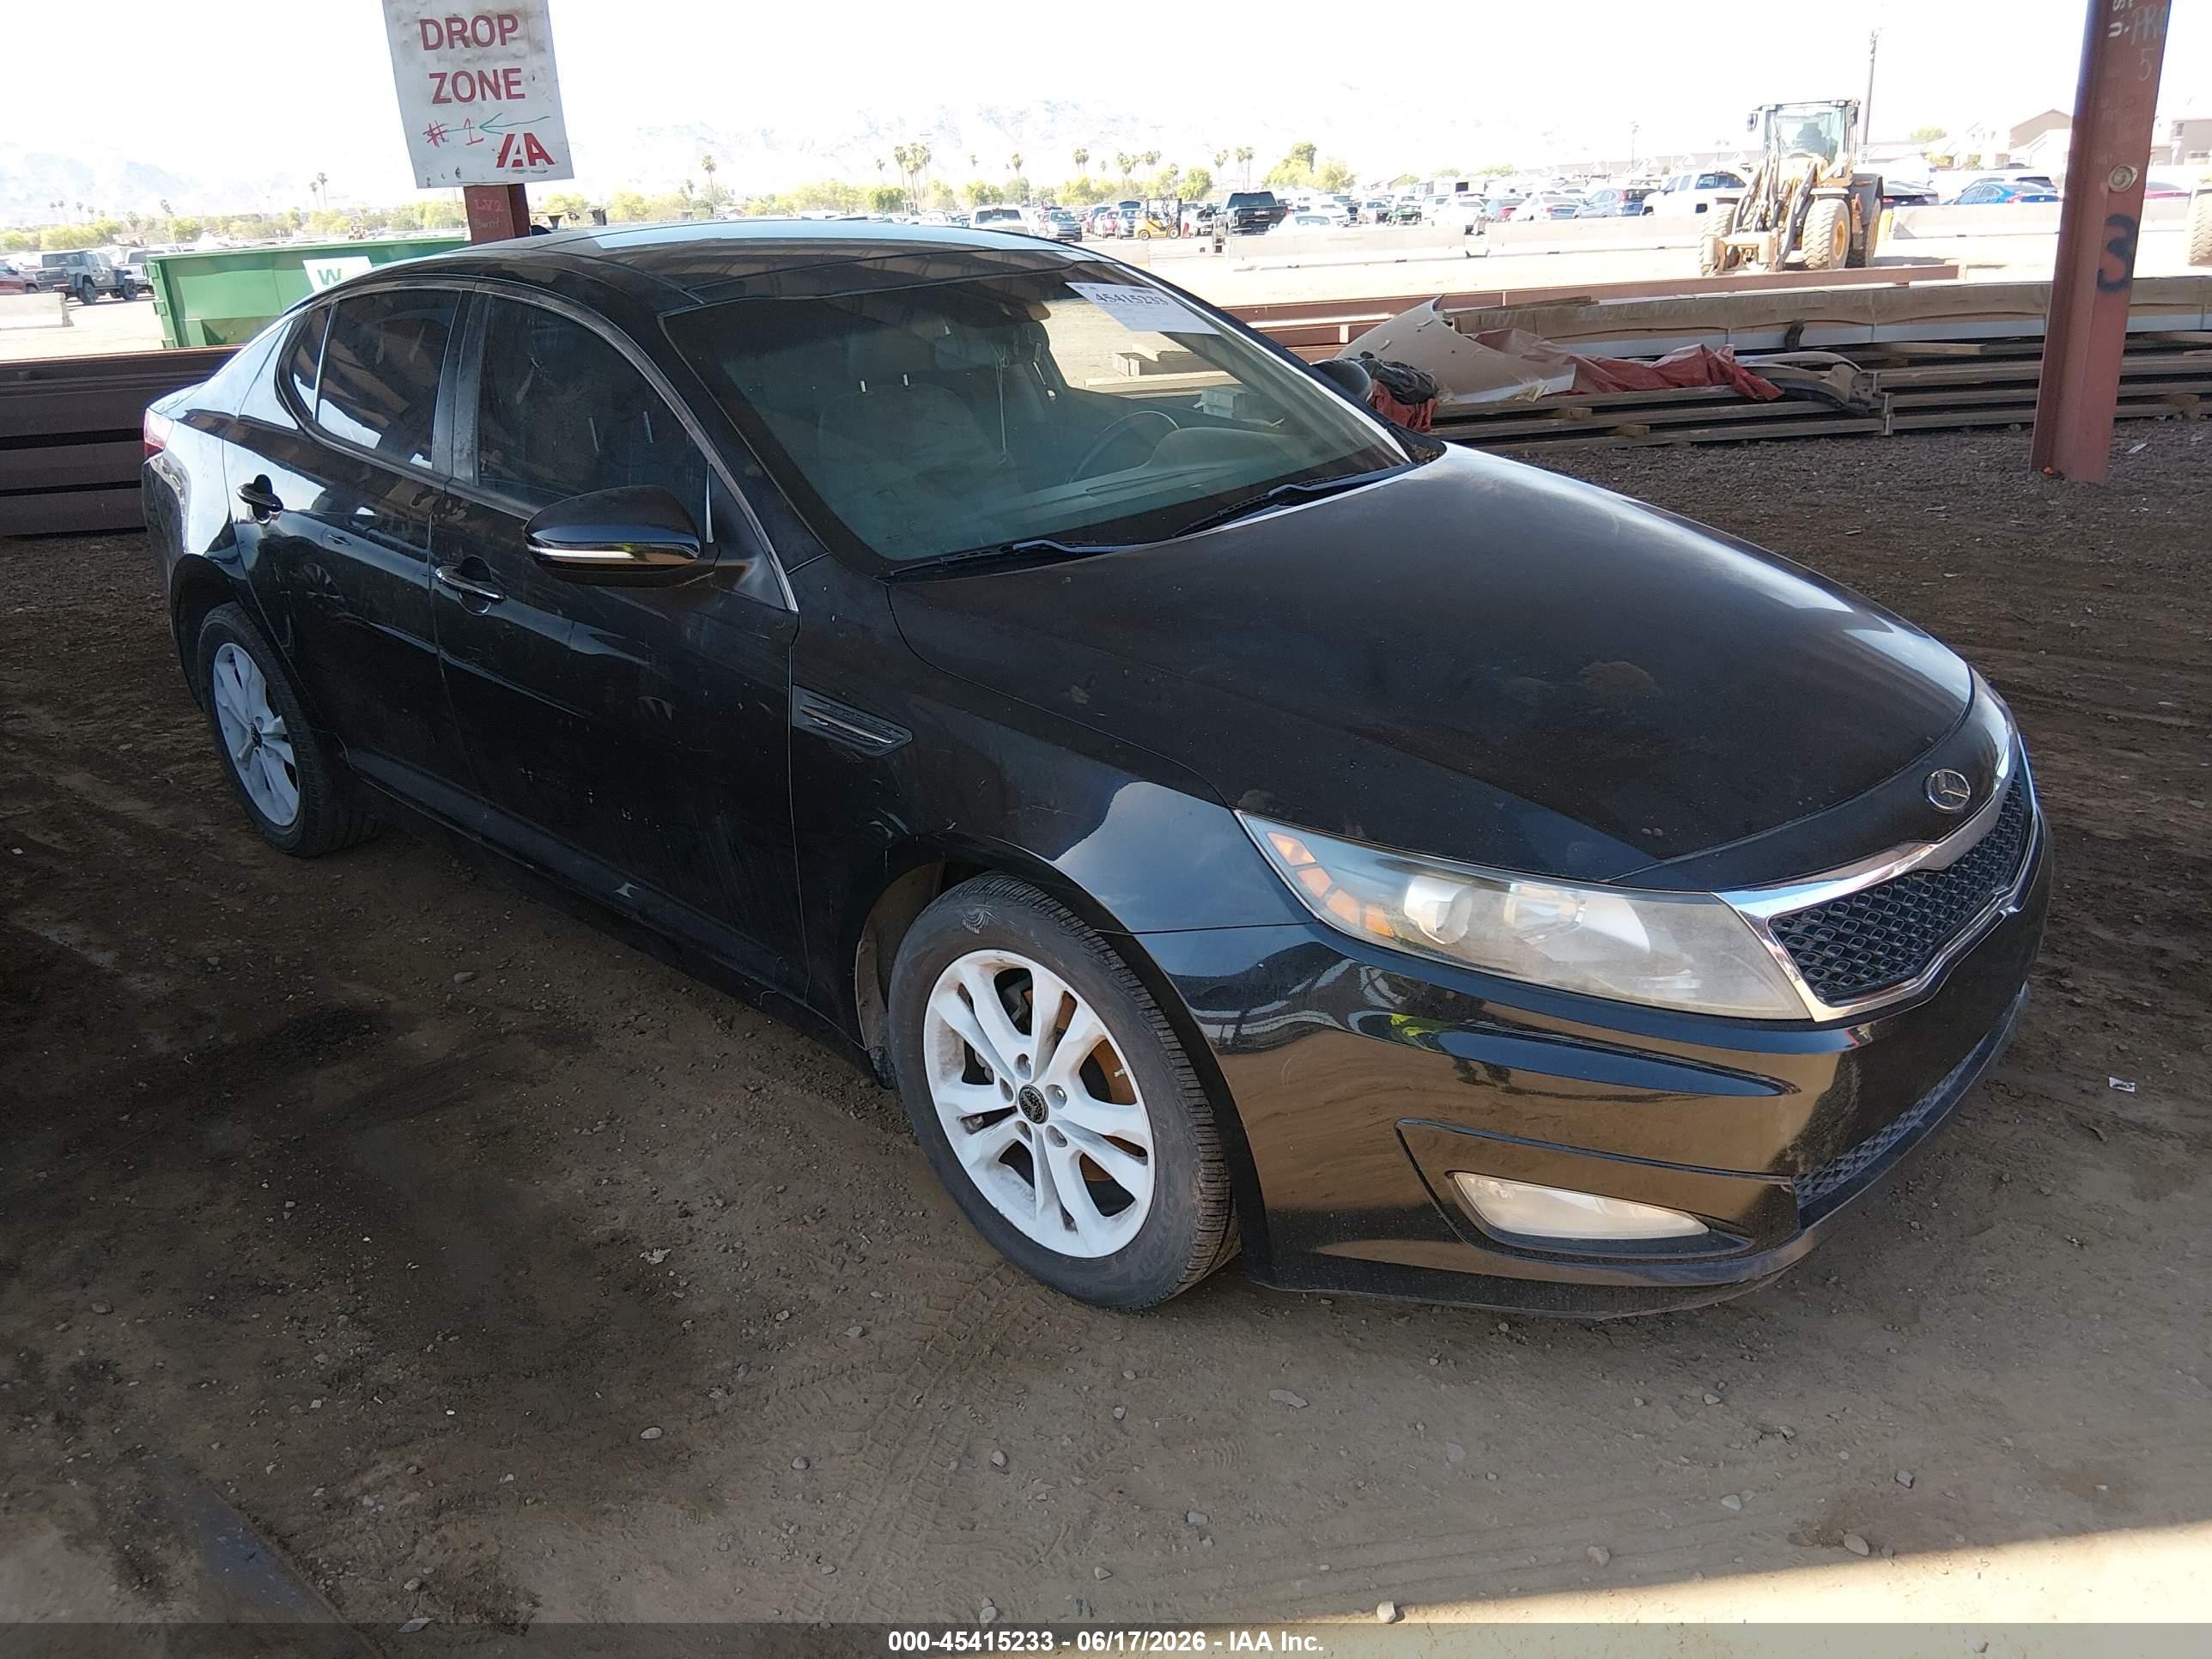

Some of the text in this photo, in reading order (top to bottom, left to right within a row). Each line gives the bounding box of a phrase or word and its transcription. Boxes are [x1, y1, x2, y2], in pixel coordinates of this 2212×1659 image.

[419, 14, 519, 51] DROP
[428, 68, 526, 104] ZONE
[2097, 214, 2136, 293] 3
[1095, 293, 1169, 306] 45415233
